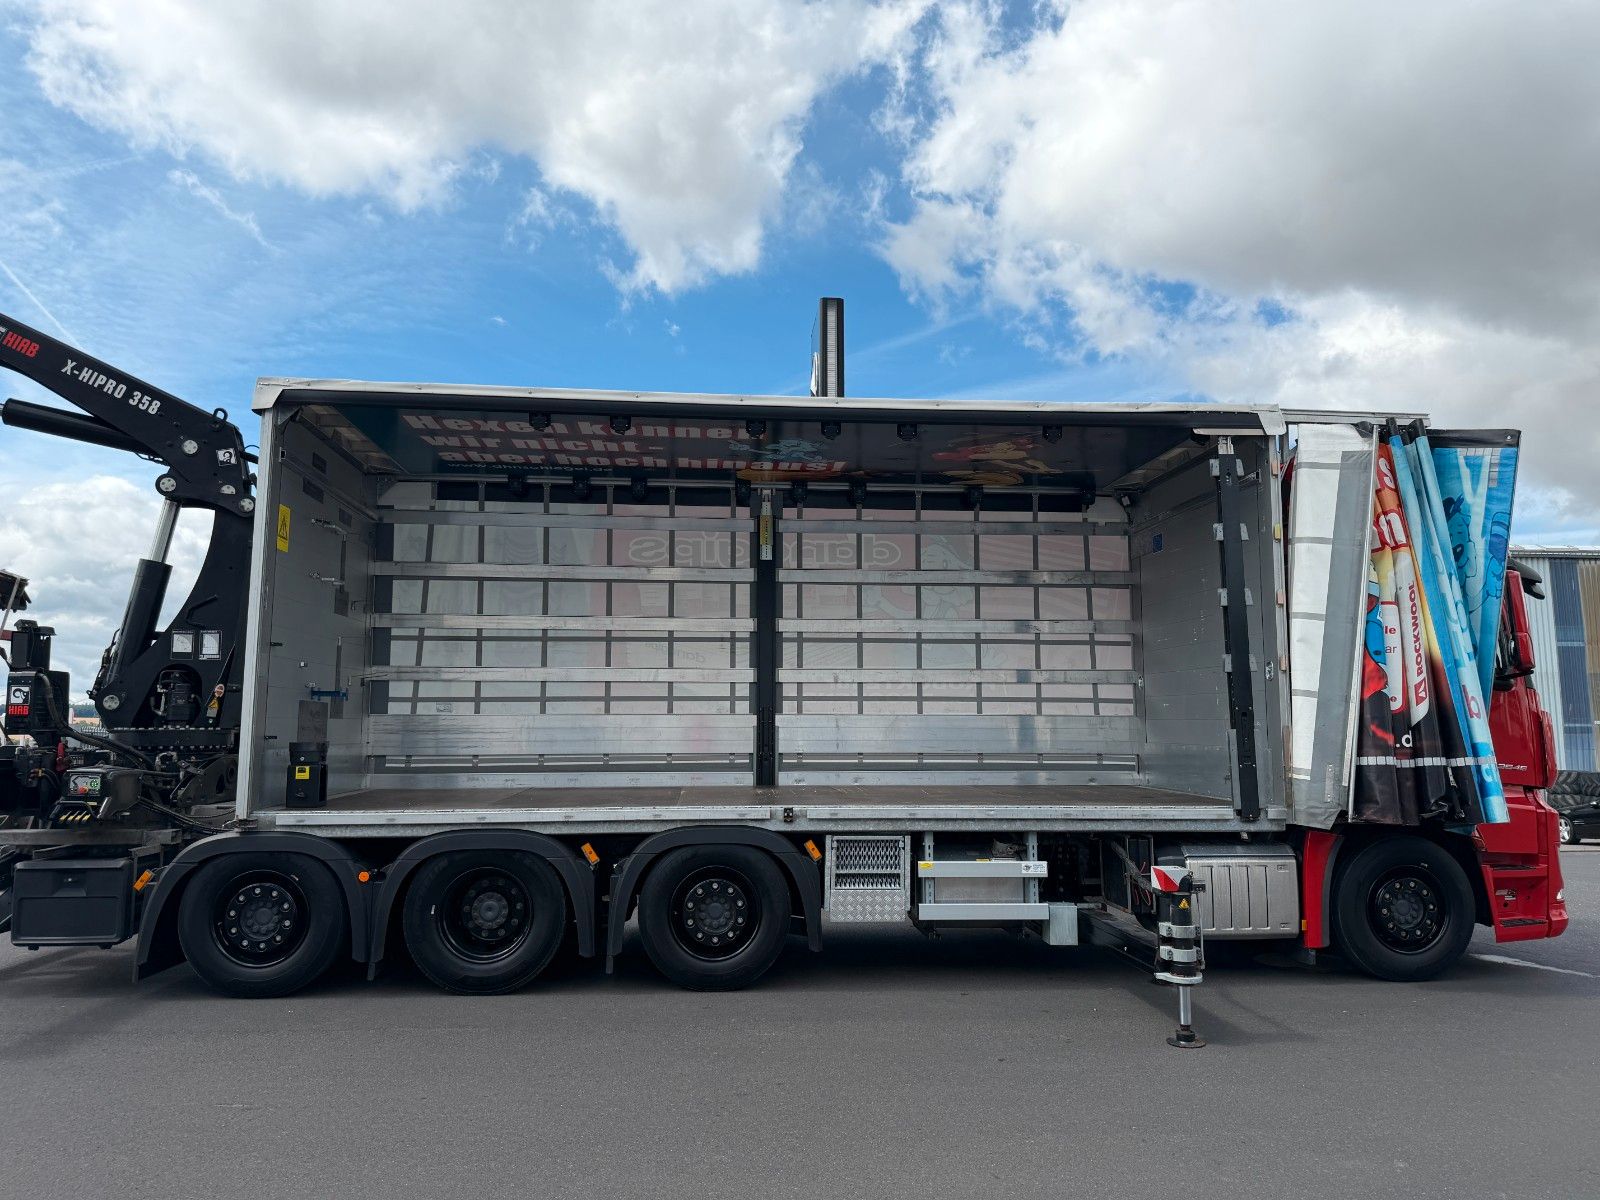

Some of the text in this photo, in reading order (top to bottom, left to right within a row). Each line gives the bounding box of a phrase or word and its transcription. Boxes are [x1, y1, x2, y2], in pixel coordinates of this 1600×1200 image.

[3, 332, 40, 358] HIAB
[61, 358, 162, 415] X-HIPRO 358
[401, 415, 569, 433] Hexen
[420, 435, 501, 448] wir
[511, 437, 640, 452] nicht
[438, 451, 546, 464] aber
[554, 453, 668, 468] hoch
[1408, 580, 1424, 677] ROCKWOOL
[9, 705, 29, 715] HIAB
